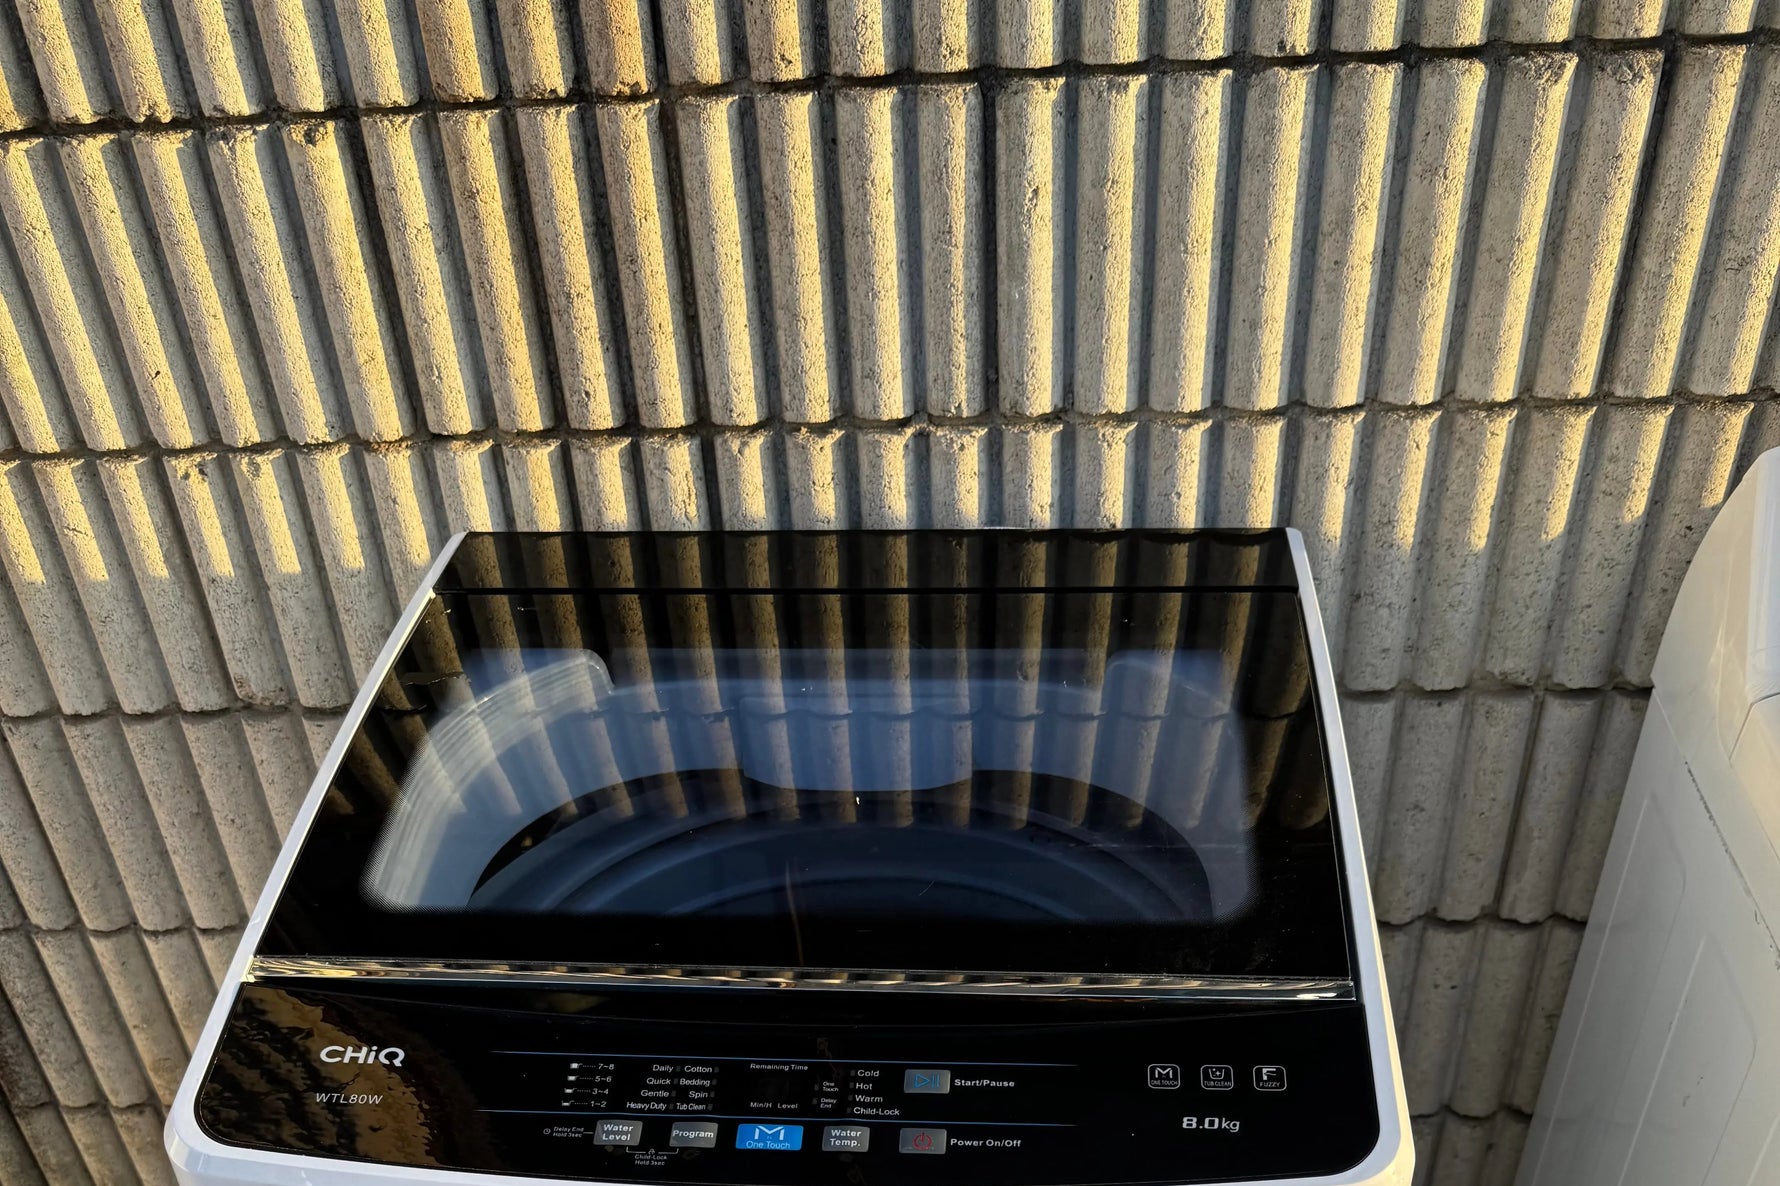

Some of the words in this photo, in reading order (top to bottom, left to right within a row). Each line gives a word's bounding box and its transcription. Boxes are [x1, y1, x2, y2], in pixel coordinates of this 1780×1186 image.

[320, 1046, 405, 1066] CHiQ
[653, 1065, 673, 1073] Daily
[750, 1063, 789, 1071] Remaining
[680, 1078, 710, 1087] Bedding
[954, 1078, 1015, 1088] Start/Pause
[315, 1093, 383, 1104] WTL80W
[689, 1091, 708, 1099] Spin
[855, 1094, 883, 1103] Warm
[626, 1101, 649, 1110] Heavy
[650, 1102, 667, 1110] Duty
[853, 1106, 900, 1116] Child-Lock
[603, 1124, 633, 1132] Water
[603, 1133, 631, 1141] Level
[672, 1129, 714, 1139] Program
[831, 1129, 862, 1137] Water
[746, 1141, 766, 1149] One
[766, 1141, 790, 1149] Touch
[830, 1138, 860, 1148] Temp.
[950, 1138, 984, 1147] Power
[985, 1139, 1021, 1148] On/Off
